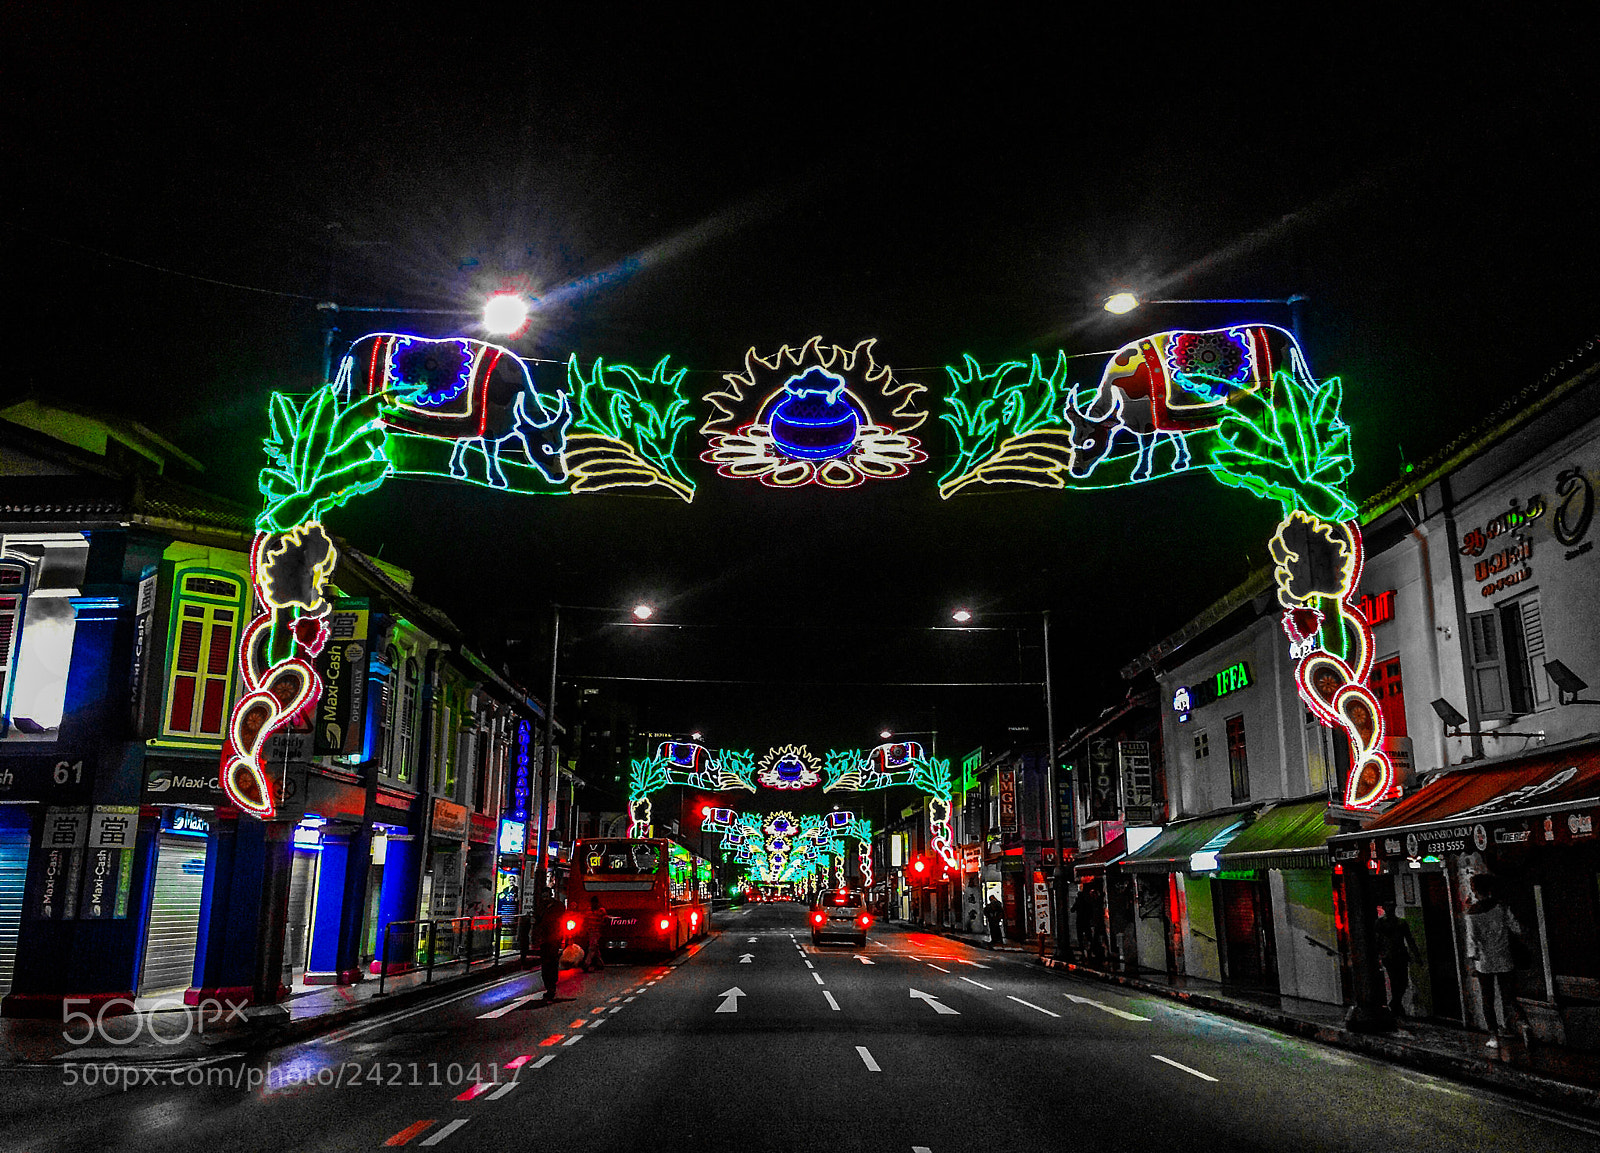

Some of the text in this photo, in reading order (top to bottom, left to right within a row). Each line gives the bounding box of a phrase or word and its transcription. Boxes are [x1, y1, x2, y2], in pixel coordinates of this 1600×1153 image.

[322, 645, 342, 721] Maxi-Cash
[353, 669, 363, 695] DAILY
[351, 697, 361, 722] OPEN
[272, 736, 304, 749] Elderly
[272, 748, 302, 760] People
[54, 760, 83, 785] 61
[118, 805, 136, 814] Daily
[1454, 826, 1473, 838] GROUP
[1427, 840, 1465, 853] 6333 5555
[43, 849, 59, 904] Maxi-Cash
[91, 849, 107, 904] Maxi-Cash
